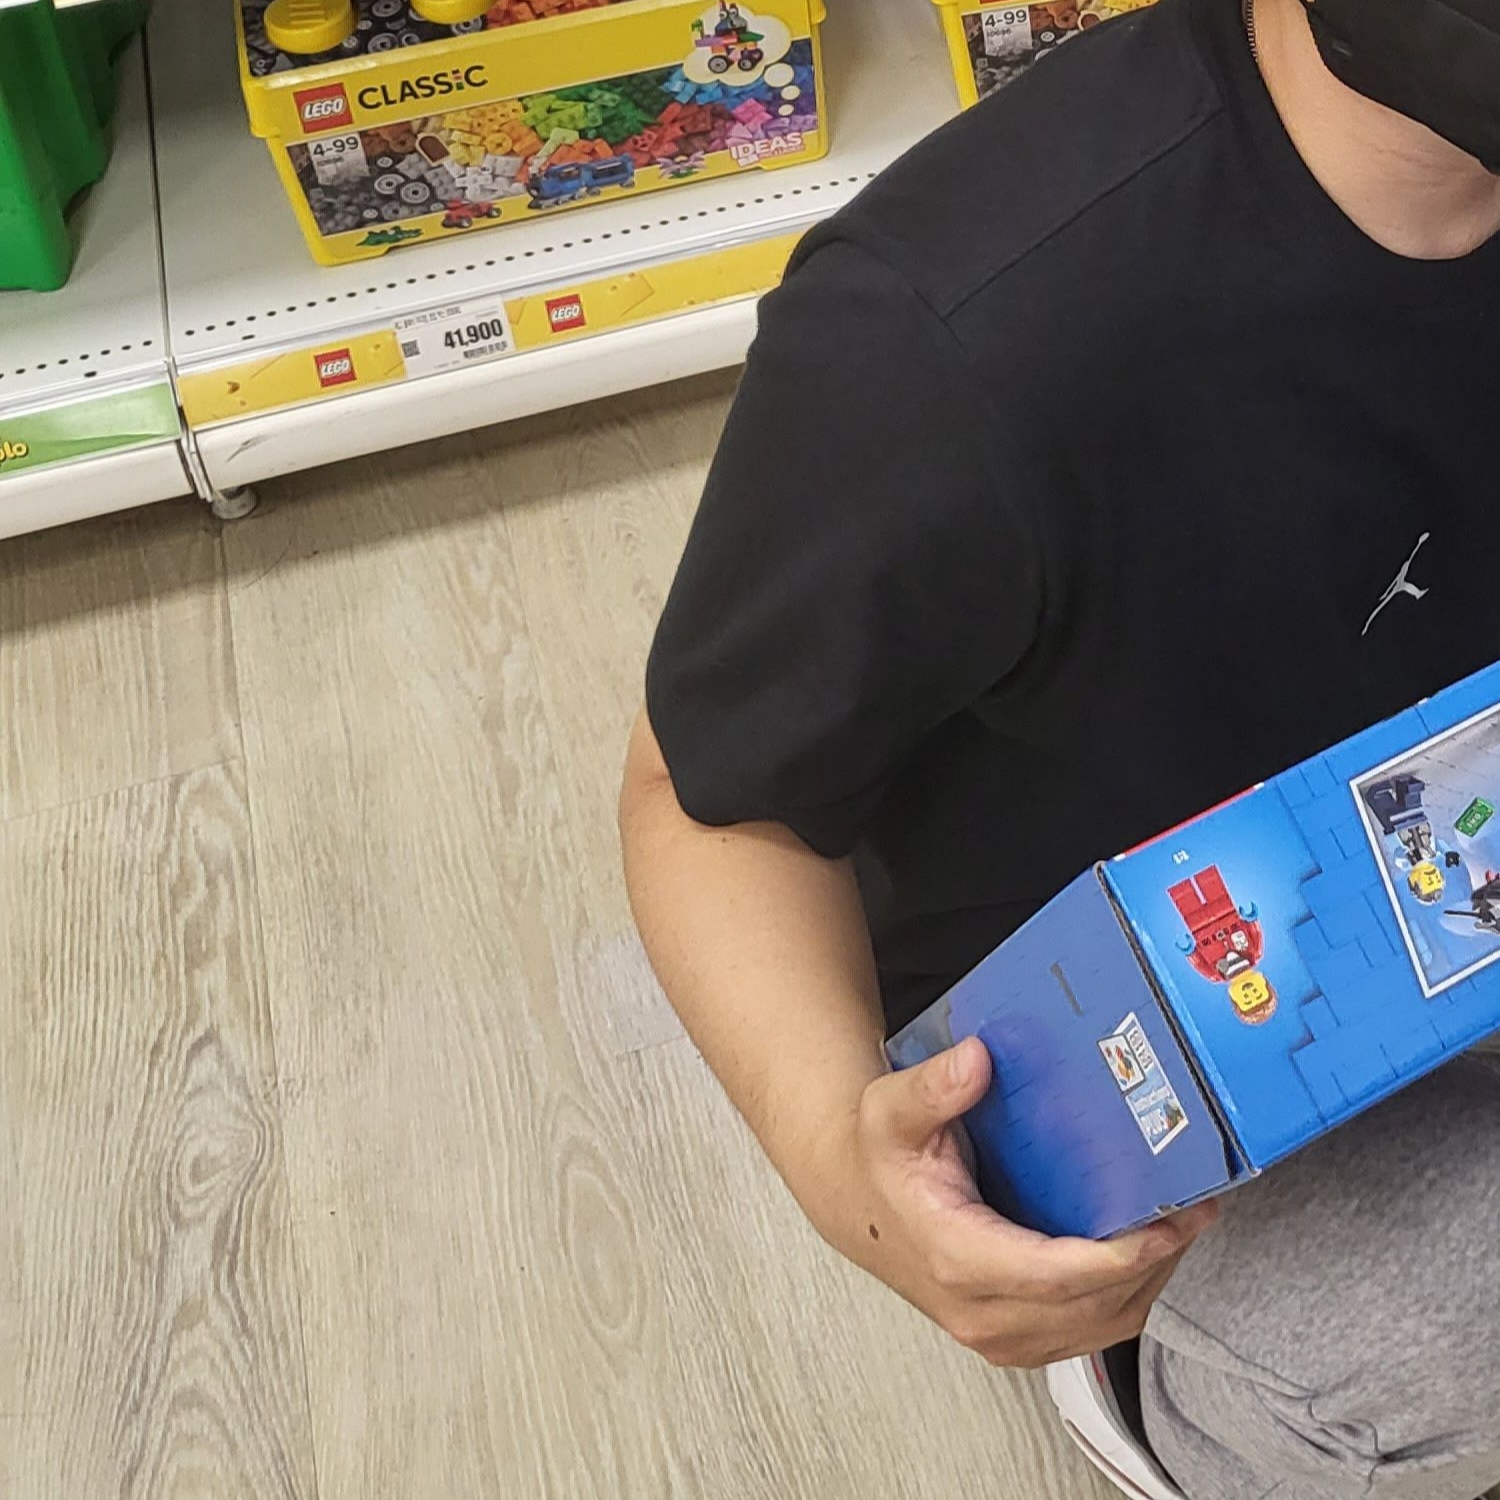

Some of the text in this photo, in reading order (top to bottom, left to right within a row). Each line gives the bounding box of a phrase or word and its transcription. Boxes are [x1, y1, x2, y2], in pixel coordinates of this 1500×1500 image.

[984, 9, 1028, 27] 4-99
[303, 65, 489, 121] LEGO CLASSIC
[312, 136, 360, 157] 4-99
[731, 132, 803, 160] IDEAS
[550, 303, 582, 321] LEGO
[441, 318, 503, 350] 41,900
[319, 358, 351, 378] LEGO
